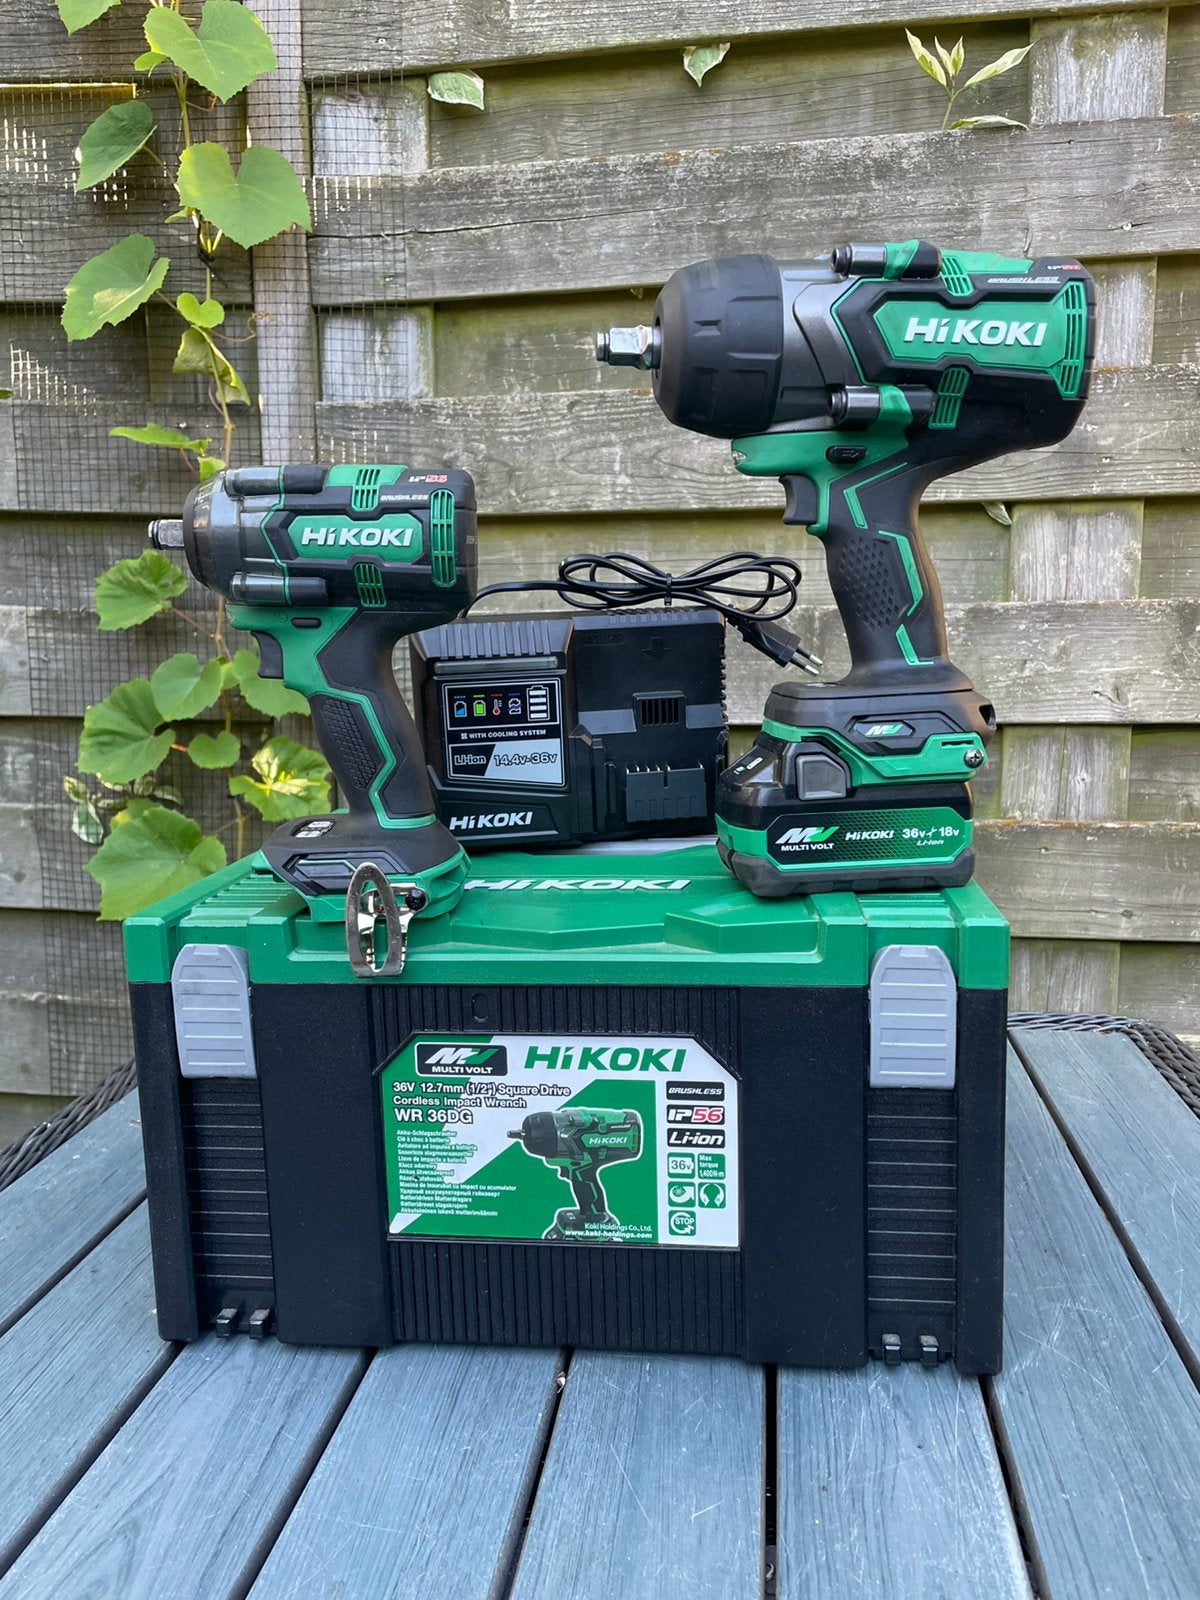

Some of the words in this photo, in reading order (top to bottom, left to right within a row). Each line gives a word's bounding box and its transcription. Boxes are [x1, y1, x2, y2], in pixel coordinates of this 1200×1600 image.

[986, 276, 1061, 284] BRUSHLESS
[903, 317, 1048, 347] HiKOKI
[301, 526, 414, 547] HiKOKI
[454, 754, 486, 765] Li-ion
[449, 811, 533, 830] HiKOKI
[845, 829, 894, 841] HiKOKI
[463, 879, 692, 890] HiKOKI
[524, 1045, 686, 1072] HiKOKI
[465, 1066, 493, 1074] VOLT
[393, 1082, 415, 1093] 36V
[420, 1083, 464, 1094] 12.7mm
[498, 1085, 541, 1096] Square
[540, 1085, 571, 1096] Drive
[668, 1087, 722, 1095] BRUSHLESS
[393, 1097, 440, 1106] Cordless
[444, 1097, 481, 1108] Impact
[485, 1098, 527, 1108] Wrench
[394, 1109, 423, 1122] WR
[427, 1110, 473, 1124] 36DG
[667, 1107, 724, 1123] IP56
[668, 1132, 724, 1145] Li-ion
[584, 1222, 599, 1230] Koki
[600, 1223, 628, 1231] Holdings
[675, 1217, 695, 1225] STOP
[565, 1230, 652, 1239] www.koki-holdings.com
